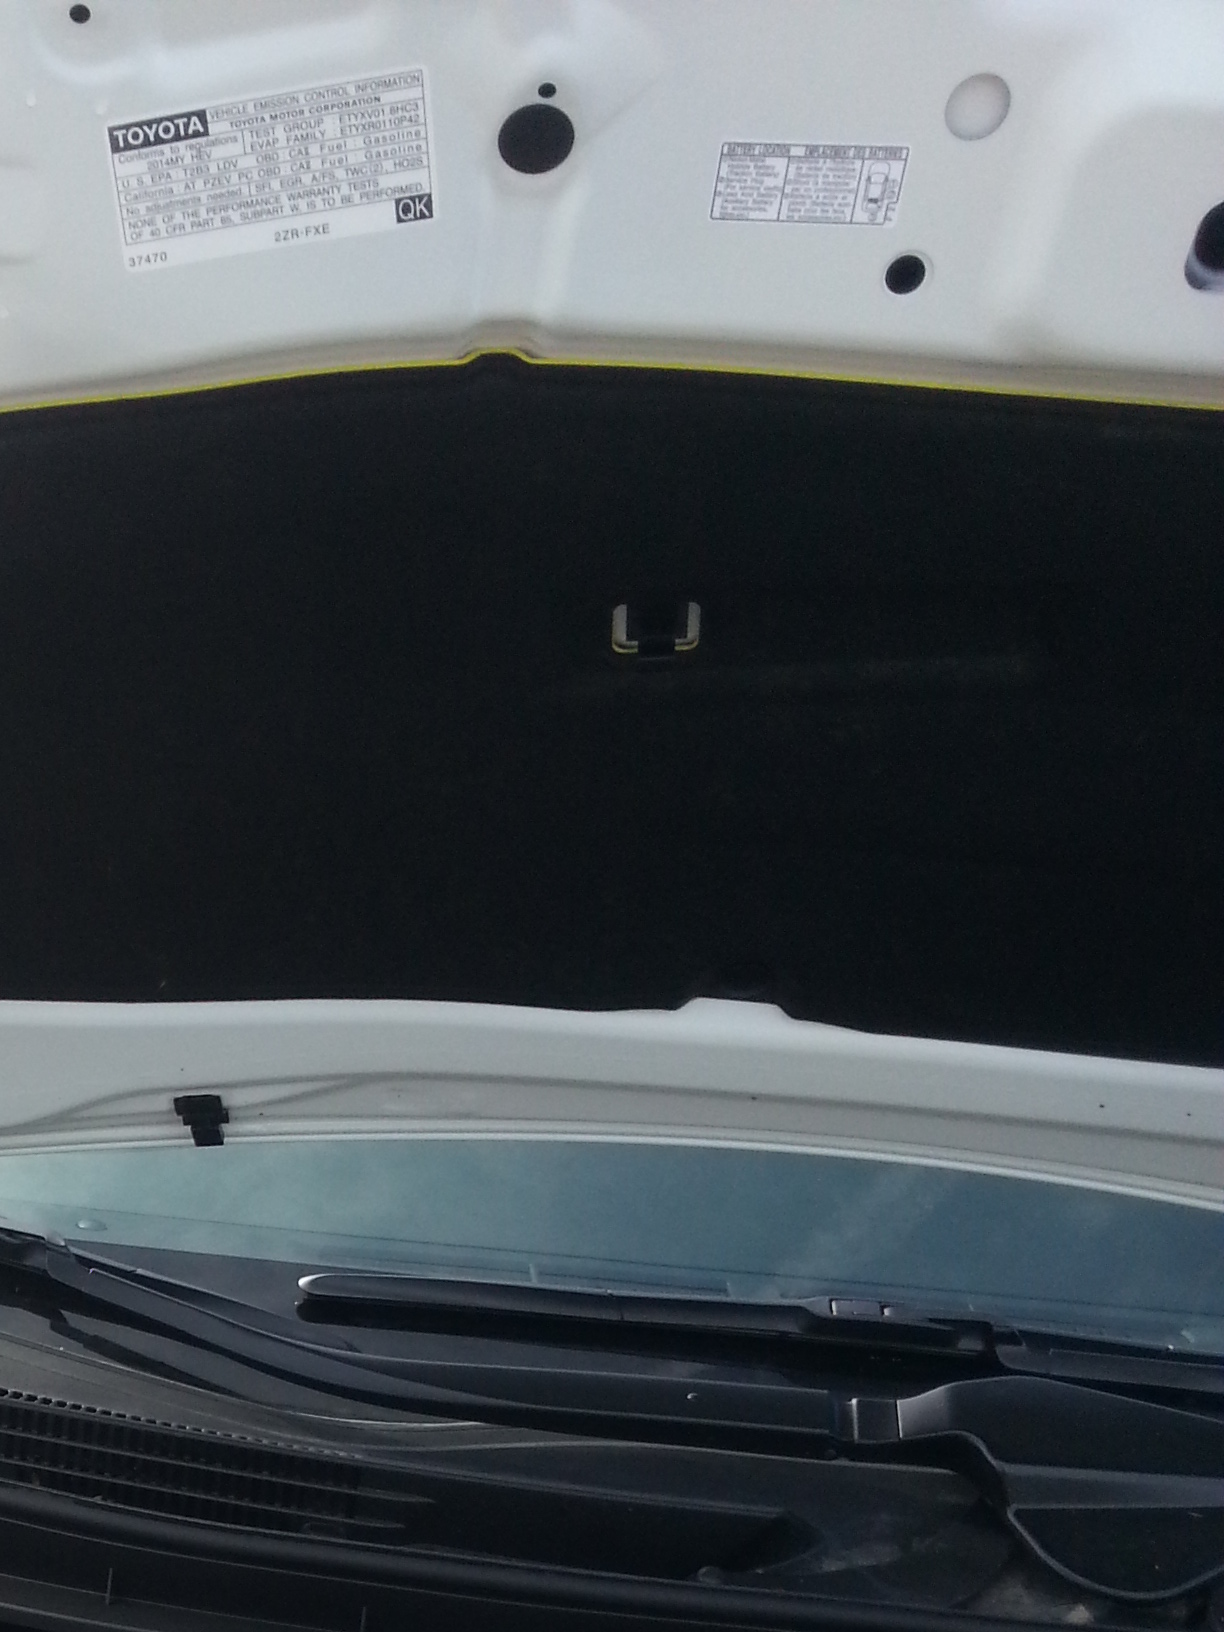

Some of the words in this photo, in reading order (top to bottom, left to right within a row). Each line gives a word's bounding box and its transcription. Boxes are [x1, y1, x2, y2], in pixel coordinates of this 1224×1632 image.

[209, 105, 247, 119] VEHICLE
[253, 95, 298, 111] EMISSION
[303, 87, 347, 103] CONTROL
[354, 74, 419, 93] INFORMATION
[230, 116, 265, 128] TOYOTA
[269, 109, 304, 121] MOTOR
[308, 96, 380, 115] CORPORATION
[113, 116, 204, 148] TOYOTA
[250, 127, 275, 139] TEST
[283, 118, 323, 133] GROUP
[250, 138, 279, 151] EVAP
[286, 129, 326, 145] FAMILY
[319, 140, 346, 153] Fuel
[363, 127, 420, 147] Gasoline
[190, 150, 212, 162] HEV
[321, 154, 348, 168] Fuel
[364, 142, 422, 161] Gasoline
[181, 209, 200, 221] THE
[205, 195, 281, 216] PERFORMANCE
[286, 184, 341, 203] WARRANTY
[349, 178, 378, 192] TESTS
[397, 196, 429, 221] QK
[274, 223, 329, 243] 2ZR-FXE
[128, 251, 167, 267] 37470
